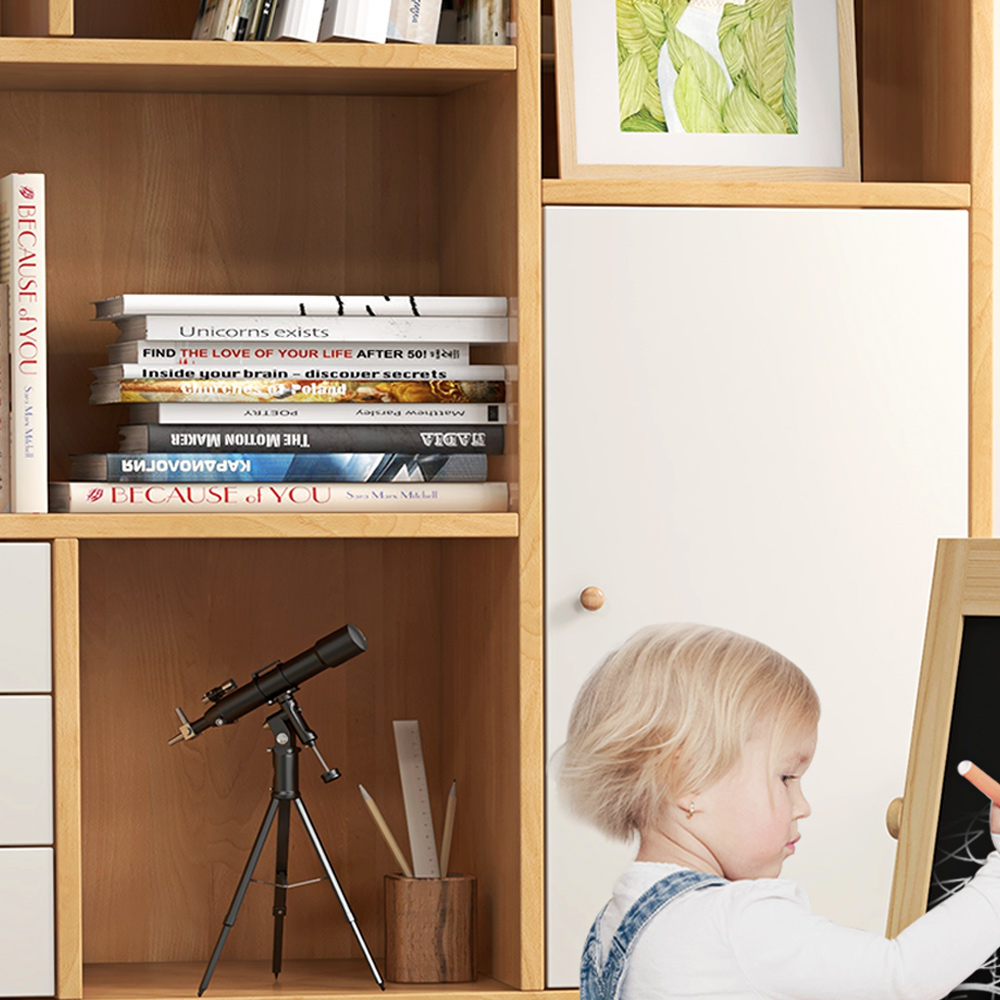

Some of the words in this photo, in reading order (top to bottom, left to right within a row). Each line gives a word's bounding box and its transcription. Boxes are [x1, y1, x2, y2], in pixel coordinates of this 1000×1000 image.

[17, 204, 37, 303] BECAUSE
[18, 307, 38, 323] of
[179, 326, 269, 338] Unicorns
[274, 326, 329, 338] exists
[18, 326, 38, 375] YOU
[142, 348, 176, 358] FIND
[180, 348, 208, 358] THE
[212, 348, 250, 358] LOVE
[254, 349, 274, 359] OF
[278, 349, 319, 359] YOUR
[322, 349, 353, 359] LIFE
[356, 349, 404, 359] AFTER
[407, 349, 427, 359] 50!
[142, 369, 195, 379] Inside
[199, 370, 240, 380] your
[243, 369, 288, 379] brain
[305, 369, 380, 379] discover
[383, 370, 447, 379] secrets
[180, 382, 262, 395] Churches
[267, 382, 285, 395] of
[292, 382, 347, 395] Poland
[355, 409, 401, 417] Parsley
[405, 409, 465, 417] Matthew
[171, 433, 221, 447] MAKER
[225, 433, 280, 447] MOTION
[284, 433, 310, 448] THE
[420, 432, 486, 447] NADIA
[121, 459, 251, 472] КАРДИОЛОГИЯ
[111, 486, 238, 504] BECAUSE
[245, 486, 264, 504] of
[270, 486, 331, 504] YOU
